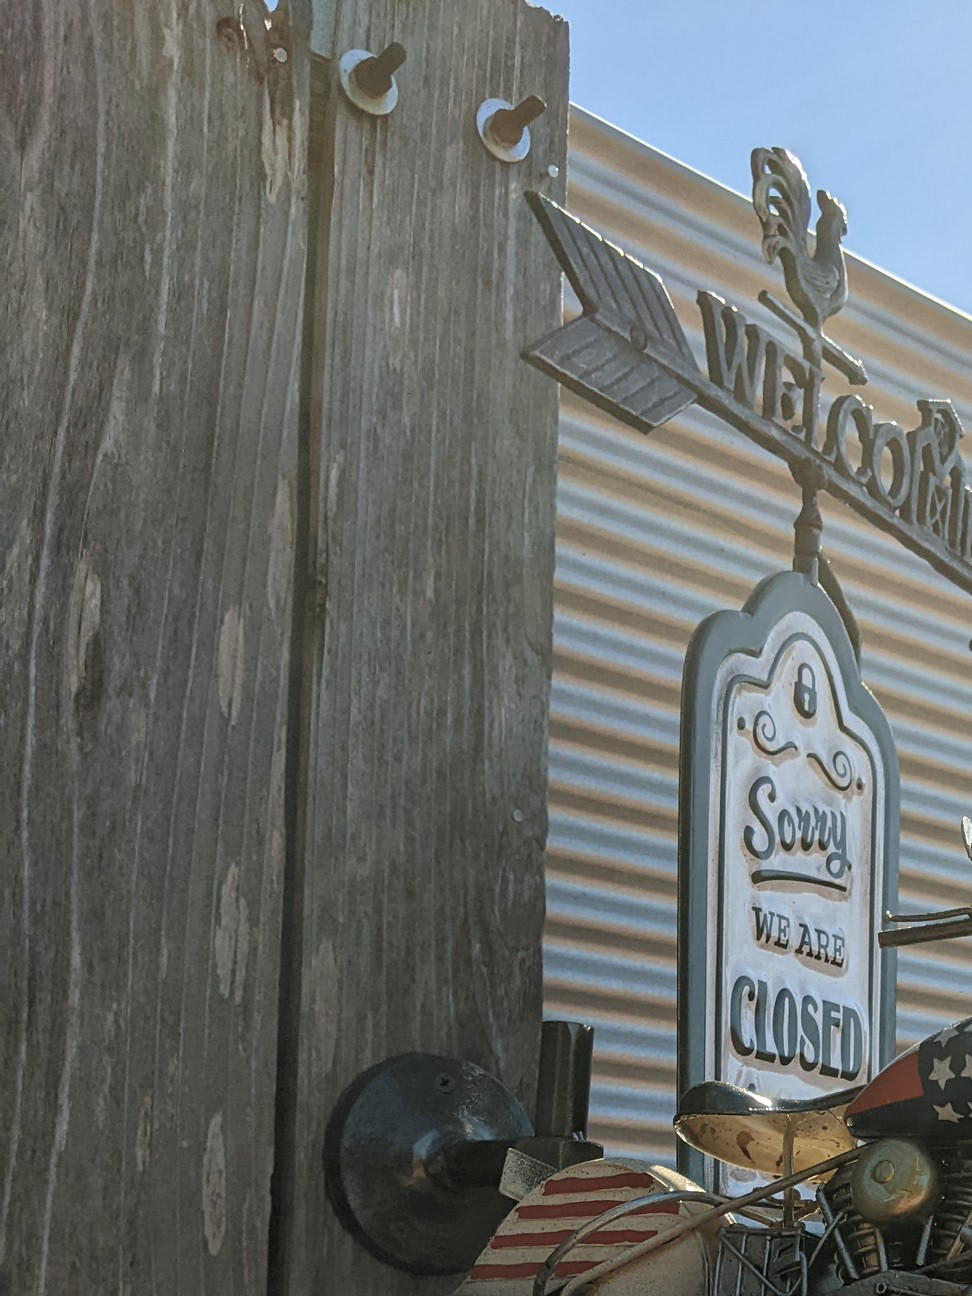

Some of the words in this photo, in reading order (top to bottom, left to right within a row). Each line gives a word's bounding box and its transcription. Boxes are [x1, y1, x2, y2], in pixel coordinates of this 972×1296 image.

[743, 776, 852, 879] Sorry
[752, 906, 791, 950] WE
[795, 922, 846, 969] ARE
[730, 975, 864, 1082] CLOSED
